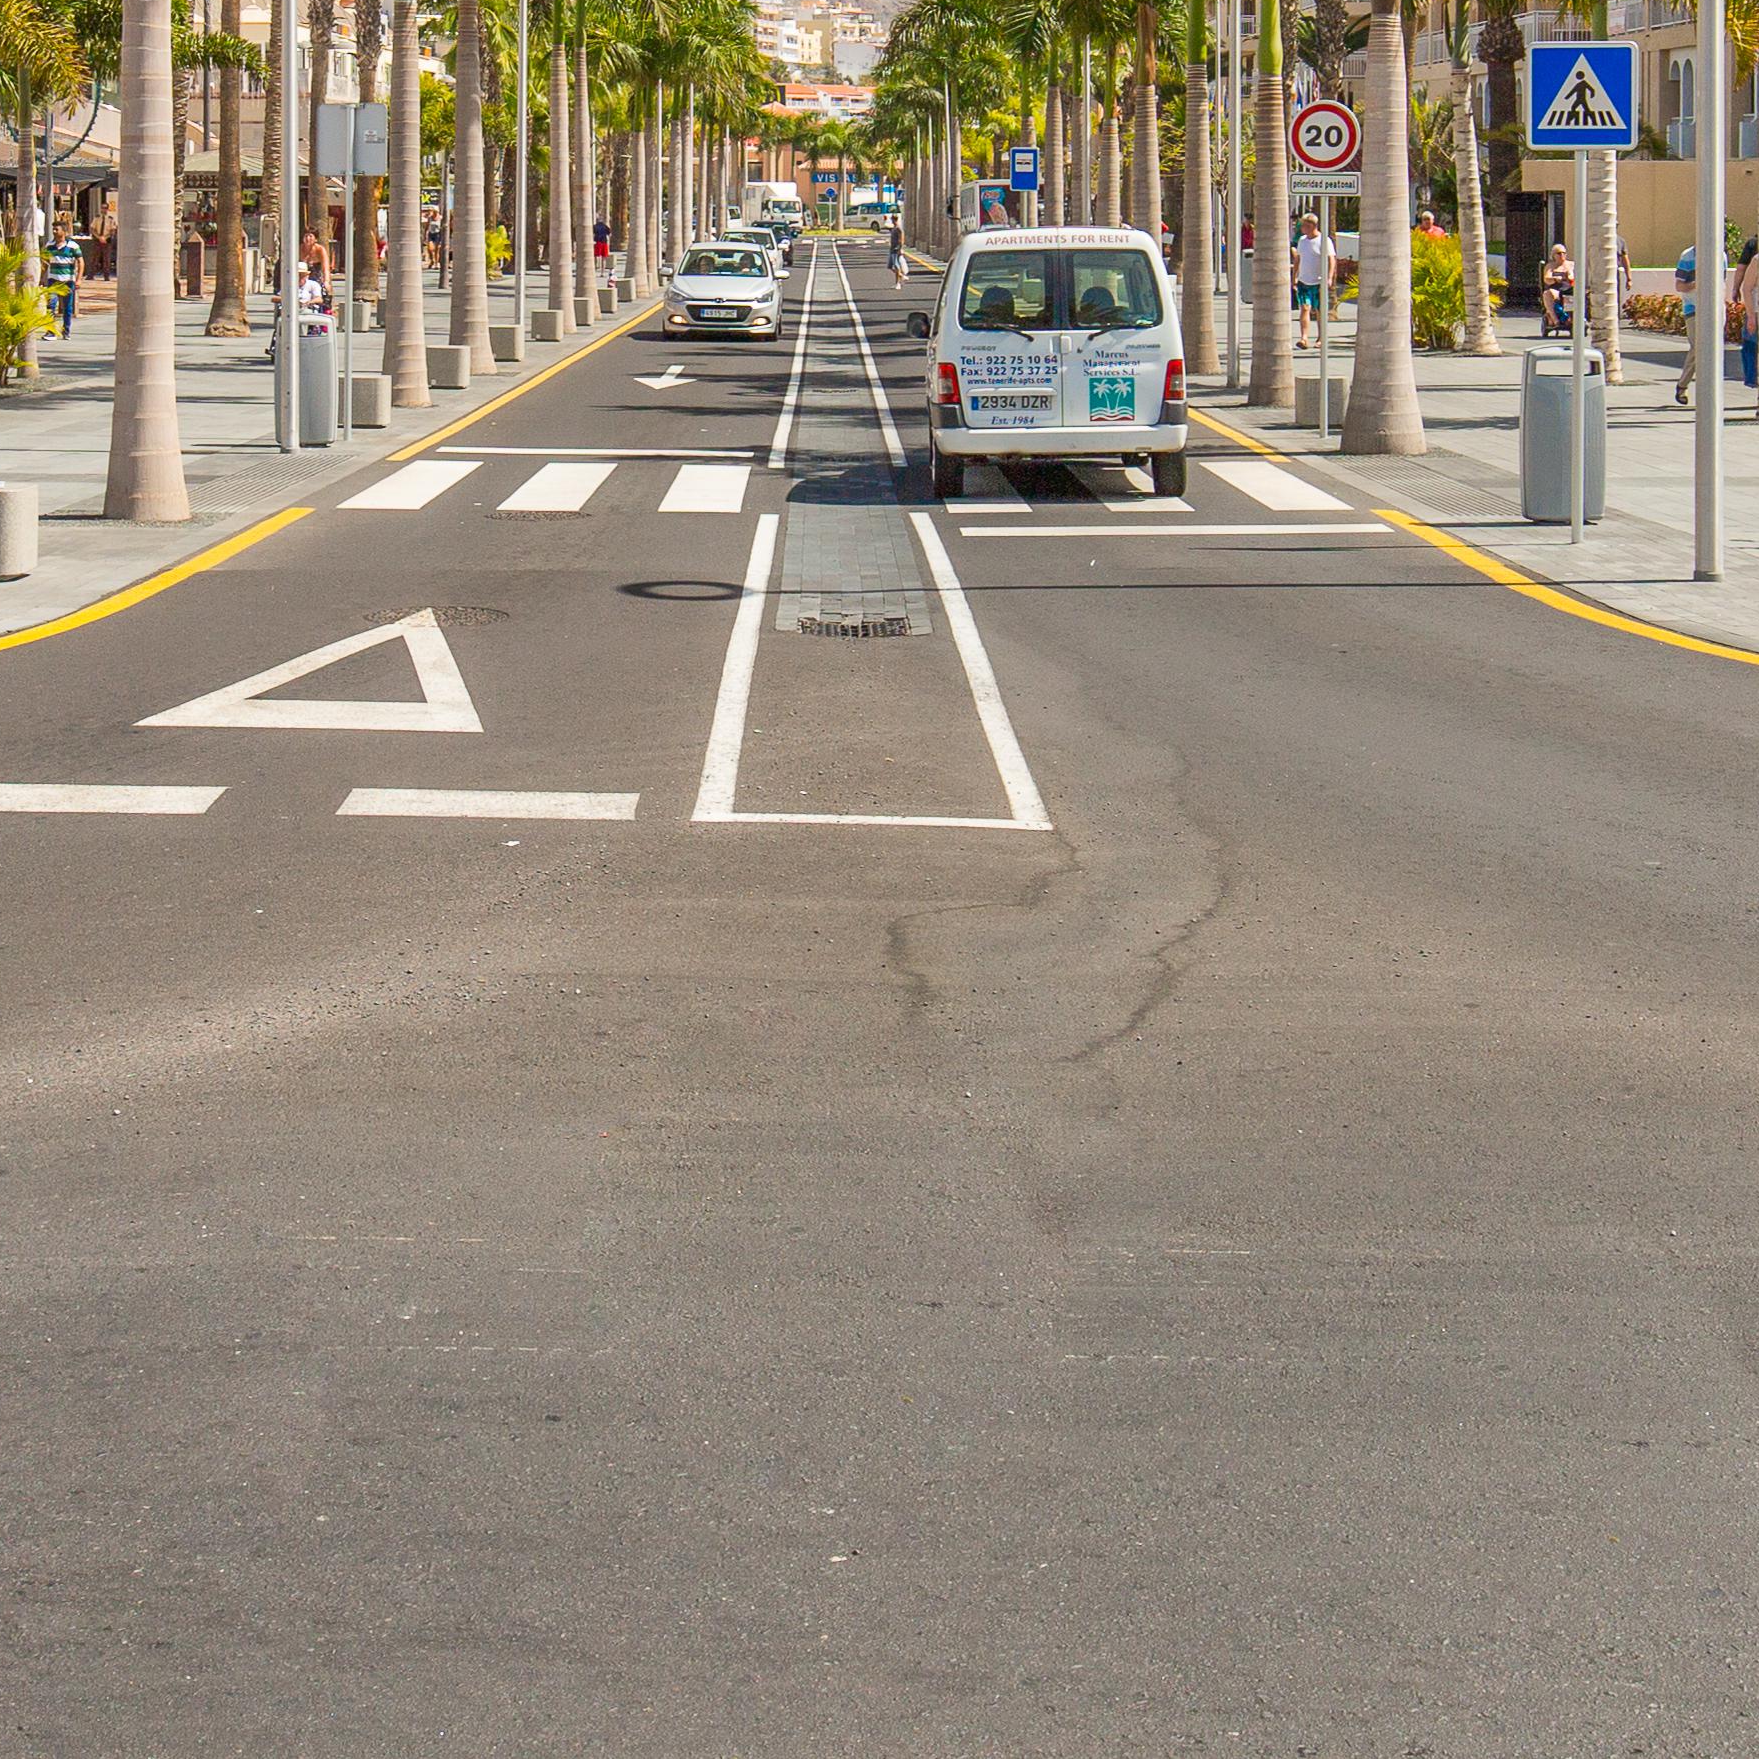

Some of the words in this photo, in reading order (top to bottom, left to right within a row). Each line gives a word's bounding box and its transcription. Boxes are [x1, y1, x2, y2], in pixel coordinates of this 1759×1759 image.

[1305, 124, 1343, 147] 20
[1293, 179, 1323, 190] prioridad
[1325, 179, 1356, 190] peatonal
[985, 234, 1067, 246] APARTMENTS
[1071, 234, 1095, 244] FOR
[1099, 234, 1129, 244] RENT
[1095, 350, 1129, 358] Marcus
[960, 356, 983, 365] Tel.:
[986, 356, 1007, 365] 922
[1010, 356, 1024, 365] 75
[1028, 356, 1041, 365] 10
[1044, 355, 1058, 365] 64
[1082, 359, 1140, 368] Management
[960, 367, 983, 376] Fax:
[986, 367, 1007, 376] 922
[1010, 367, 1024, 376] 75
[1028, 367, 1041, 375] 37
[1044, 366, 1058, 375] 25
[1083, 368, 1120, 376] Services
[967, 377, 1052, 385] www.tenerife-apts.com
[981, 395, 1017, 409] 2934
[1021, 395, 1049, 409] DZR
[991, 416, 1009, 425] Est.
[1012, 416, 1035, 425] 1984
